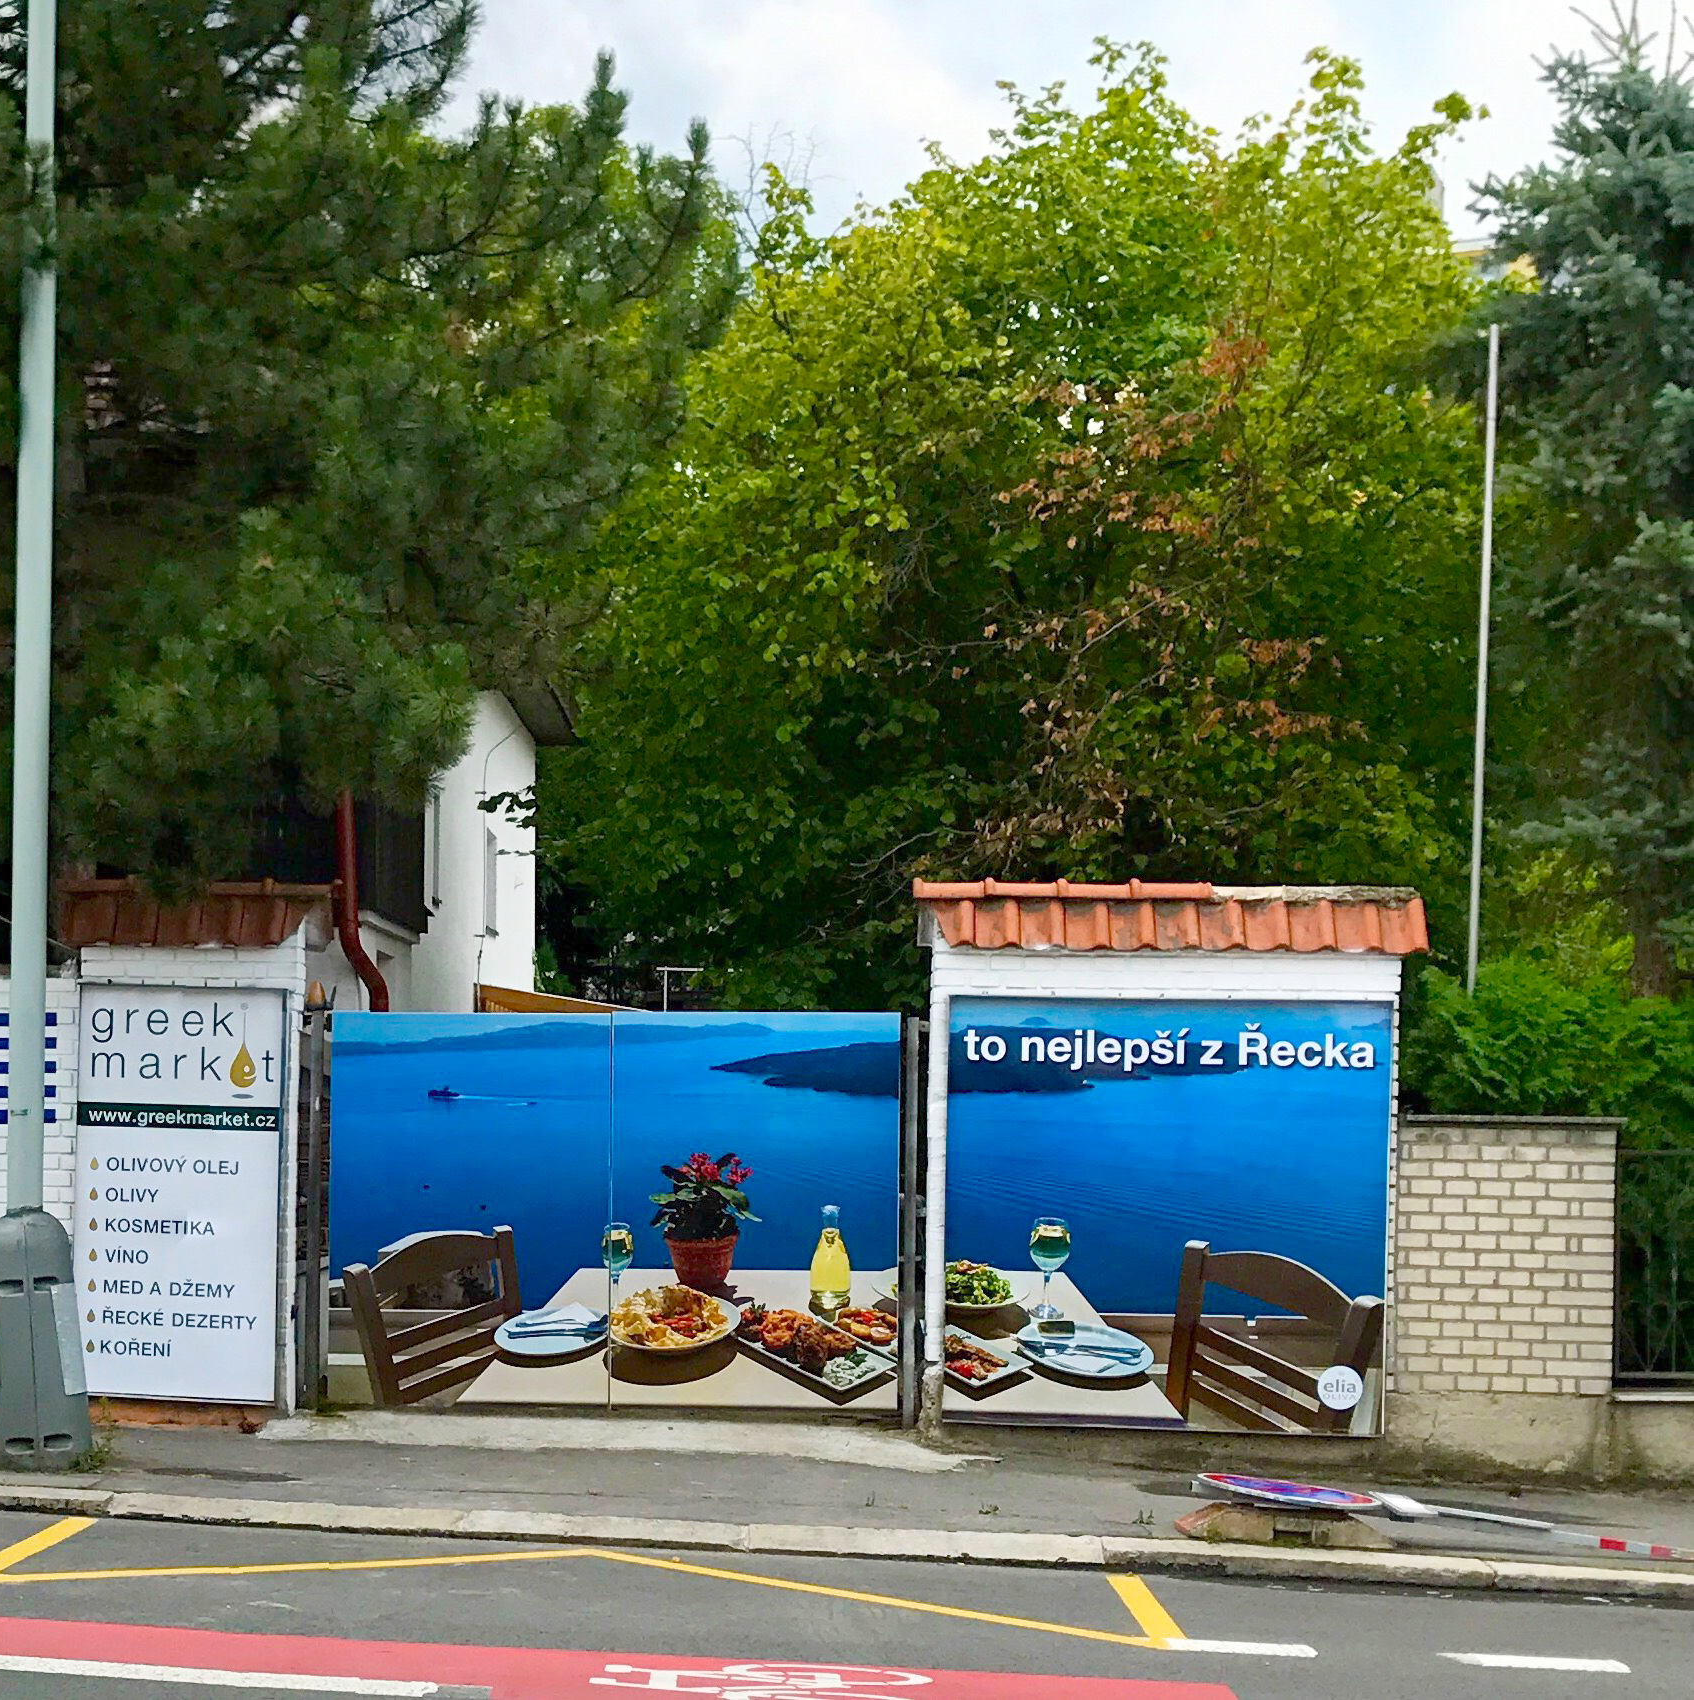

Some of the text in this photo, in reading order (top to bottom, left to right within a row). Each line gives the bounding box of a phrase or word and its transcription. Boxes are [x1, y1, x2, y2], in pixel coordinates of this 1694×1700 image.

[91, 1002, 234, 1043] greek
[963, 1022, 1375, 1072] to nejlepší z Řecka
[91, 1045, 275, 1088] market
[88, 1109, 276, 1127] www.greekmarket.cz
[106, 1155, 239, 1176] OLIVOVÝ OLEJ
[105, 1187, 159, 1203] OLIVY
[105, 1218, 215, 1236] KOSMETIKA
[105, 1246, 149, 1264] VÍNO
[103, 1278, 235, 1298] MED A DŽEMY
[102, 1306, 257, 1331] ŘECKÉ DEZERTY
[100, 1337, 172, 1358] KOŘENÍ
[1323, 1379, 1357, 1393] elia
